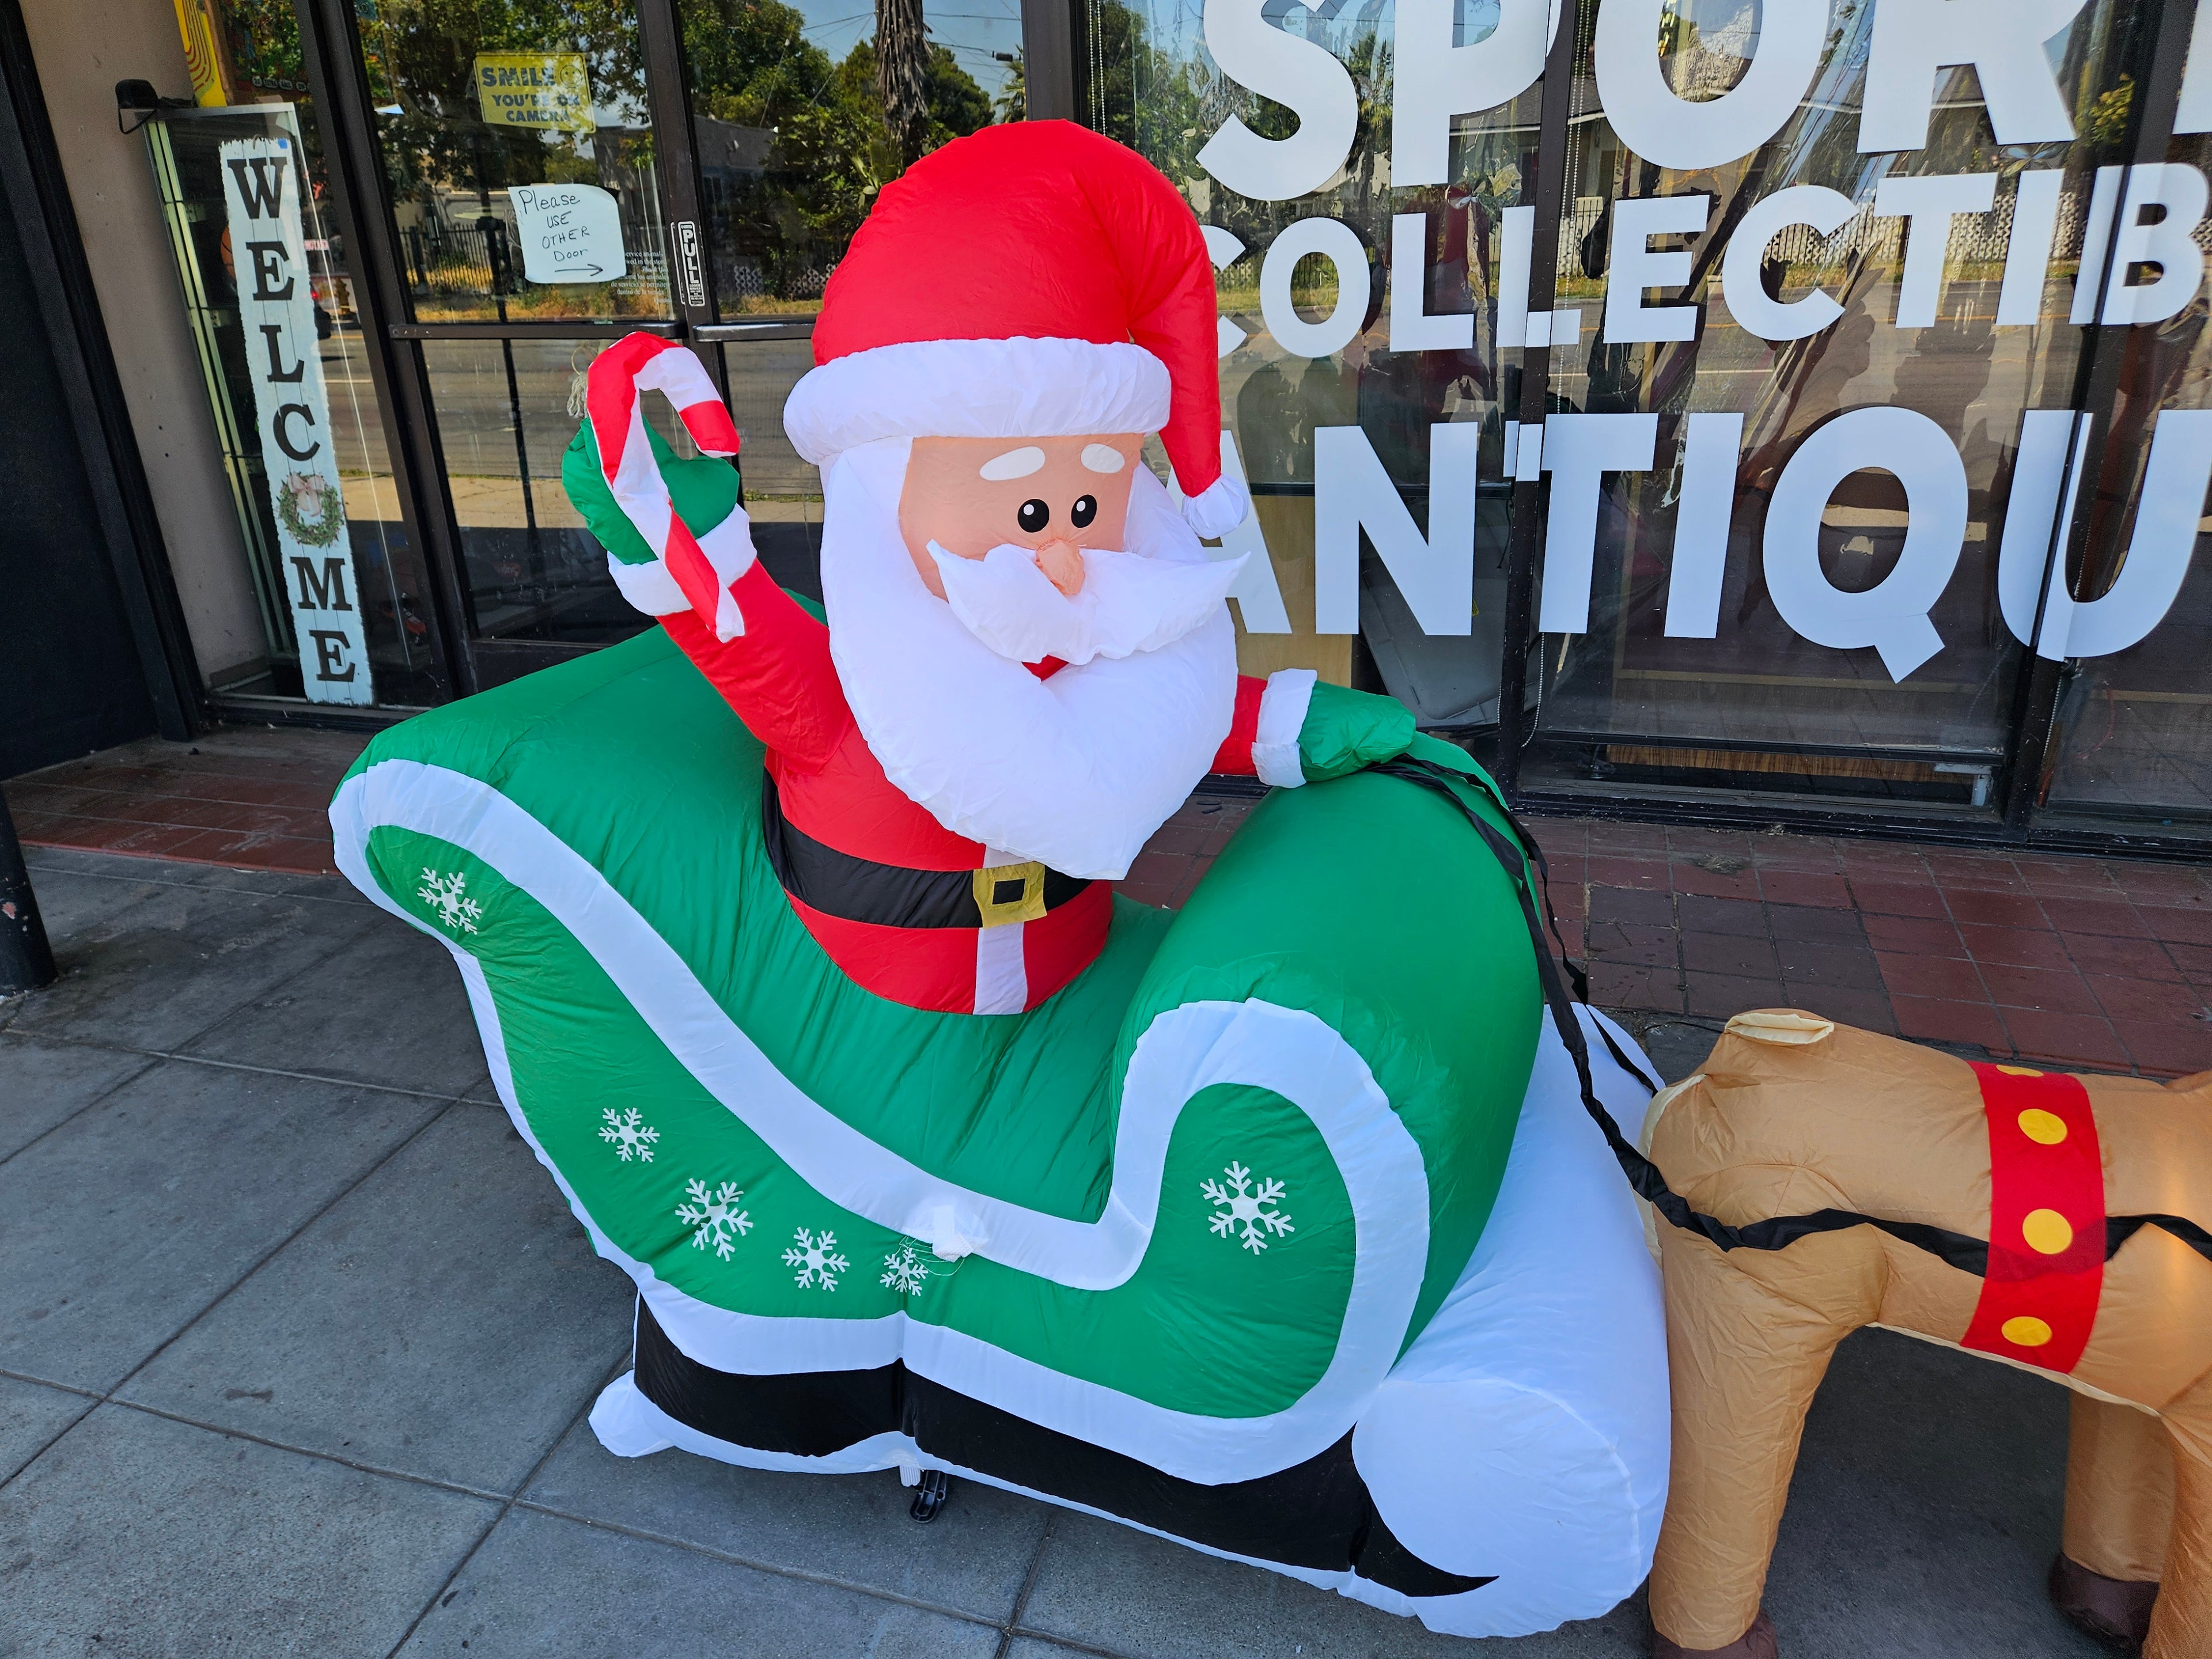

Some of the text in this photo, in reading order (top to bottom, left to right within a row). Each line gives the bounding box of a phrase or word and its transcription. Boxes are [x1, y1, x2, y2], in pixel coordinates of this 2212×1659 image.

[481, 67, 556, 87] SMILE
[492, 94, 550, 107] YOU'RE
[1195, 0, 2212, 200] SPOR
[506, 109, 571, 122] CAMERA
[518, 190, 580, 214] Please
[547, 211, 571, 228] USE
[542, 226, 590, 249] OTHER
[554, 249, 588, 262] Door
[683, 229, 699, 283] PULL
